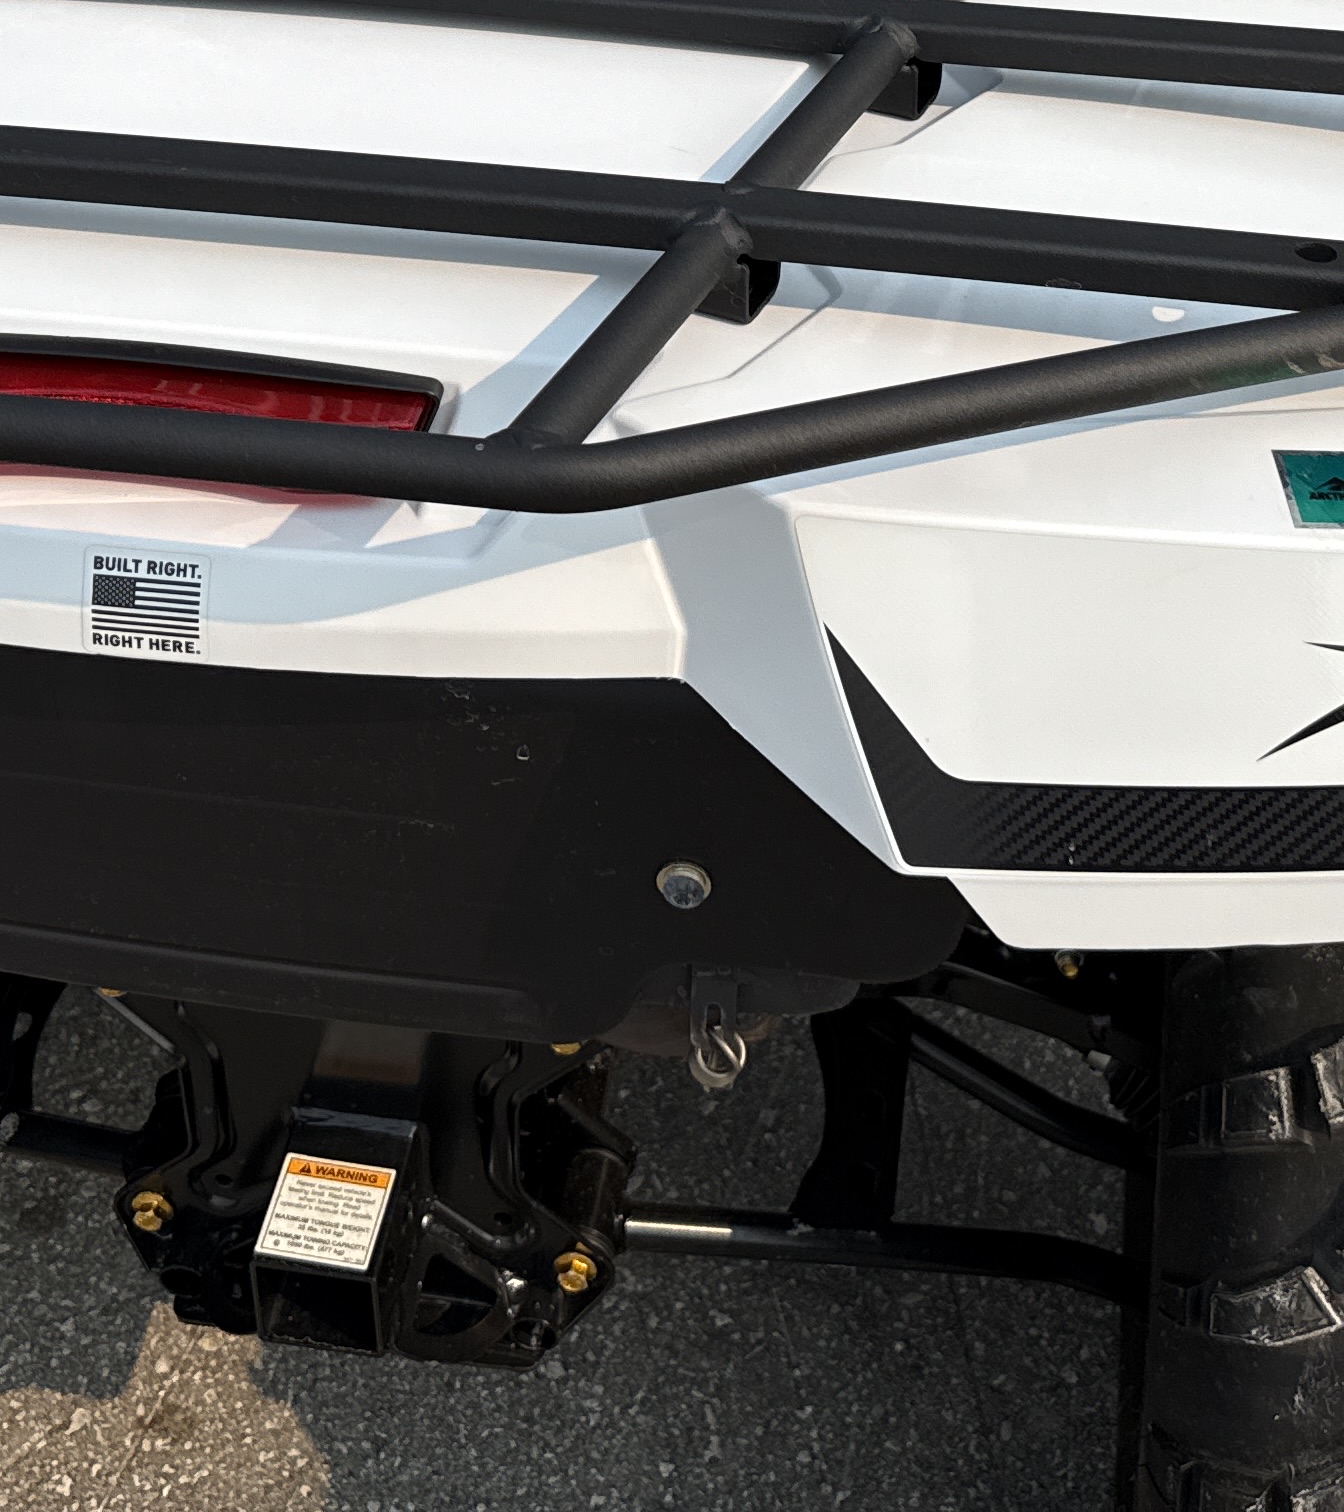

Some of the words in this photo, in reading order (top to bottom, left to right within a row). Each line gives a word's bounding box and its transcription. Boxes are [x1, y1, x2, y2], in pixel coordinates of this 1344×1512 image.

[93, 555, 143, 574] BUILT
[146, 560, 202, 580] RIGHT.
[92, 632, 144, 649] RIGHT
[149, 638, 202, 655] HERE.
[315, 1165, 379, 1184] WARNING
